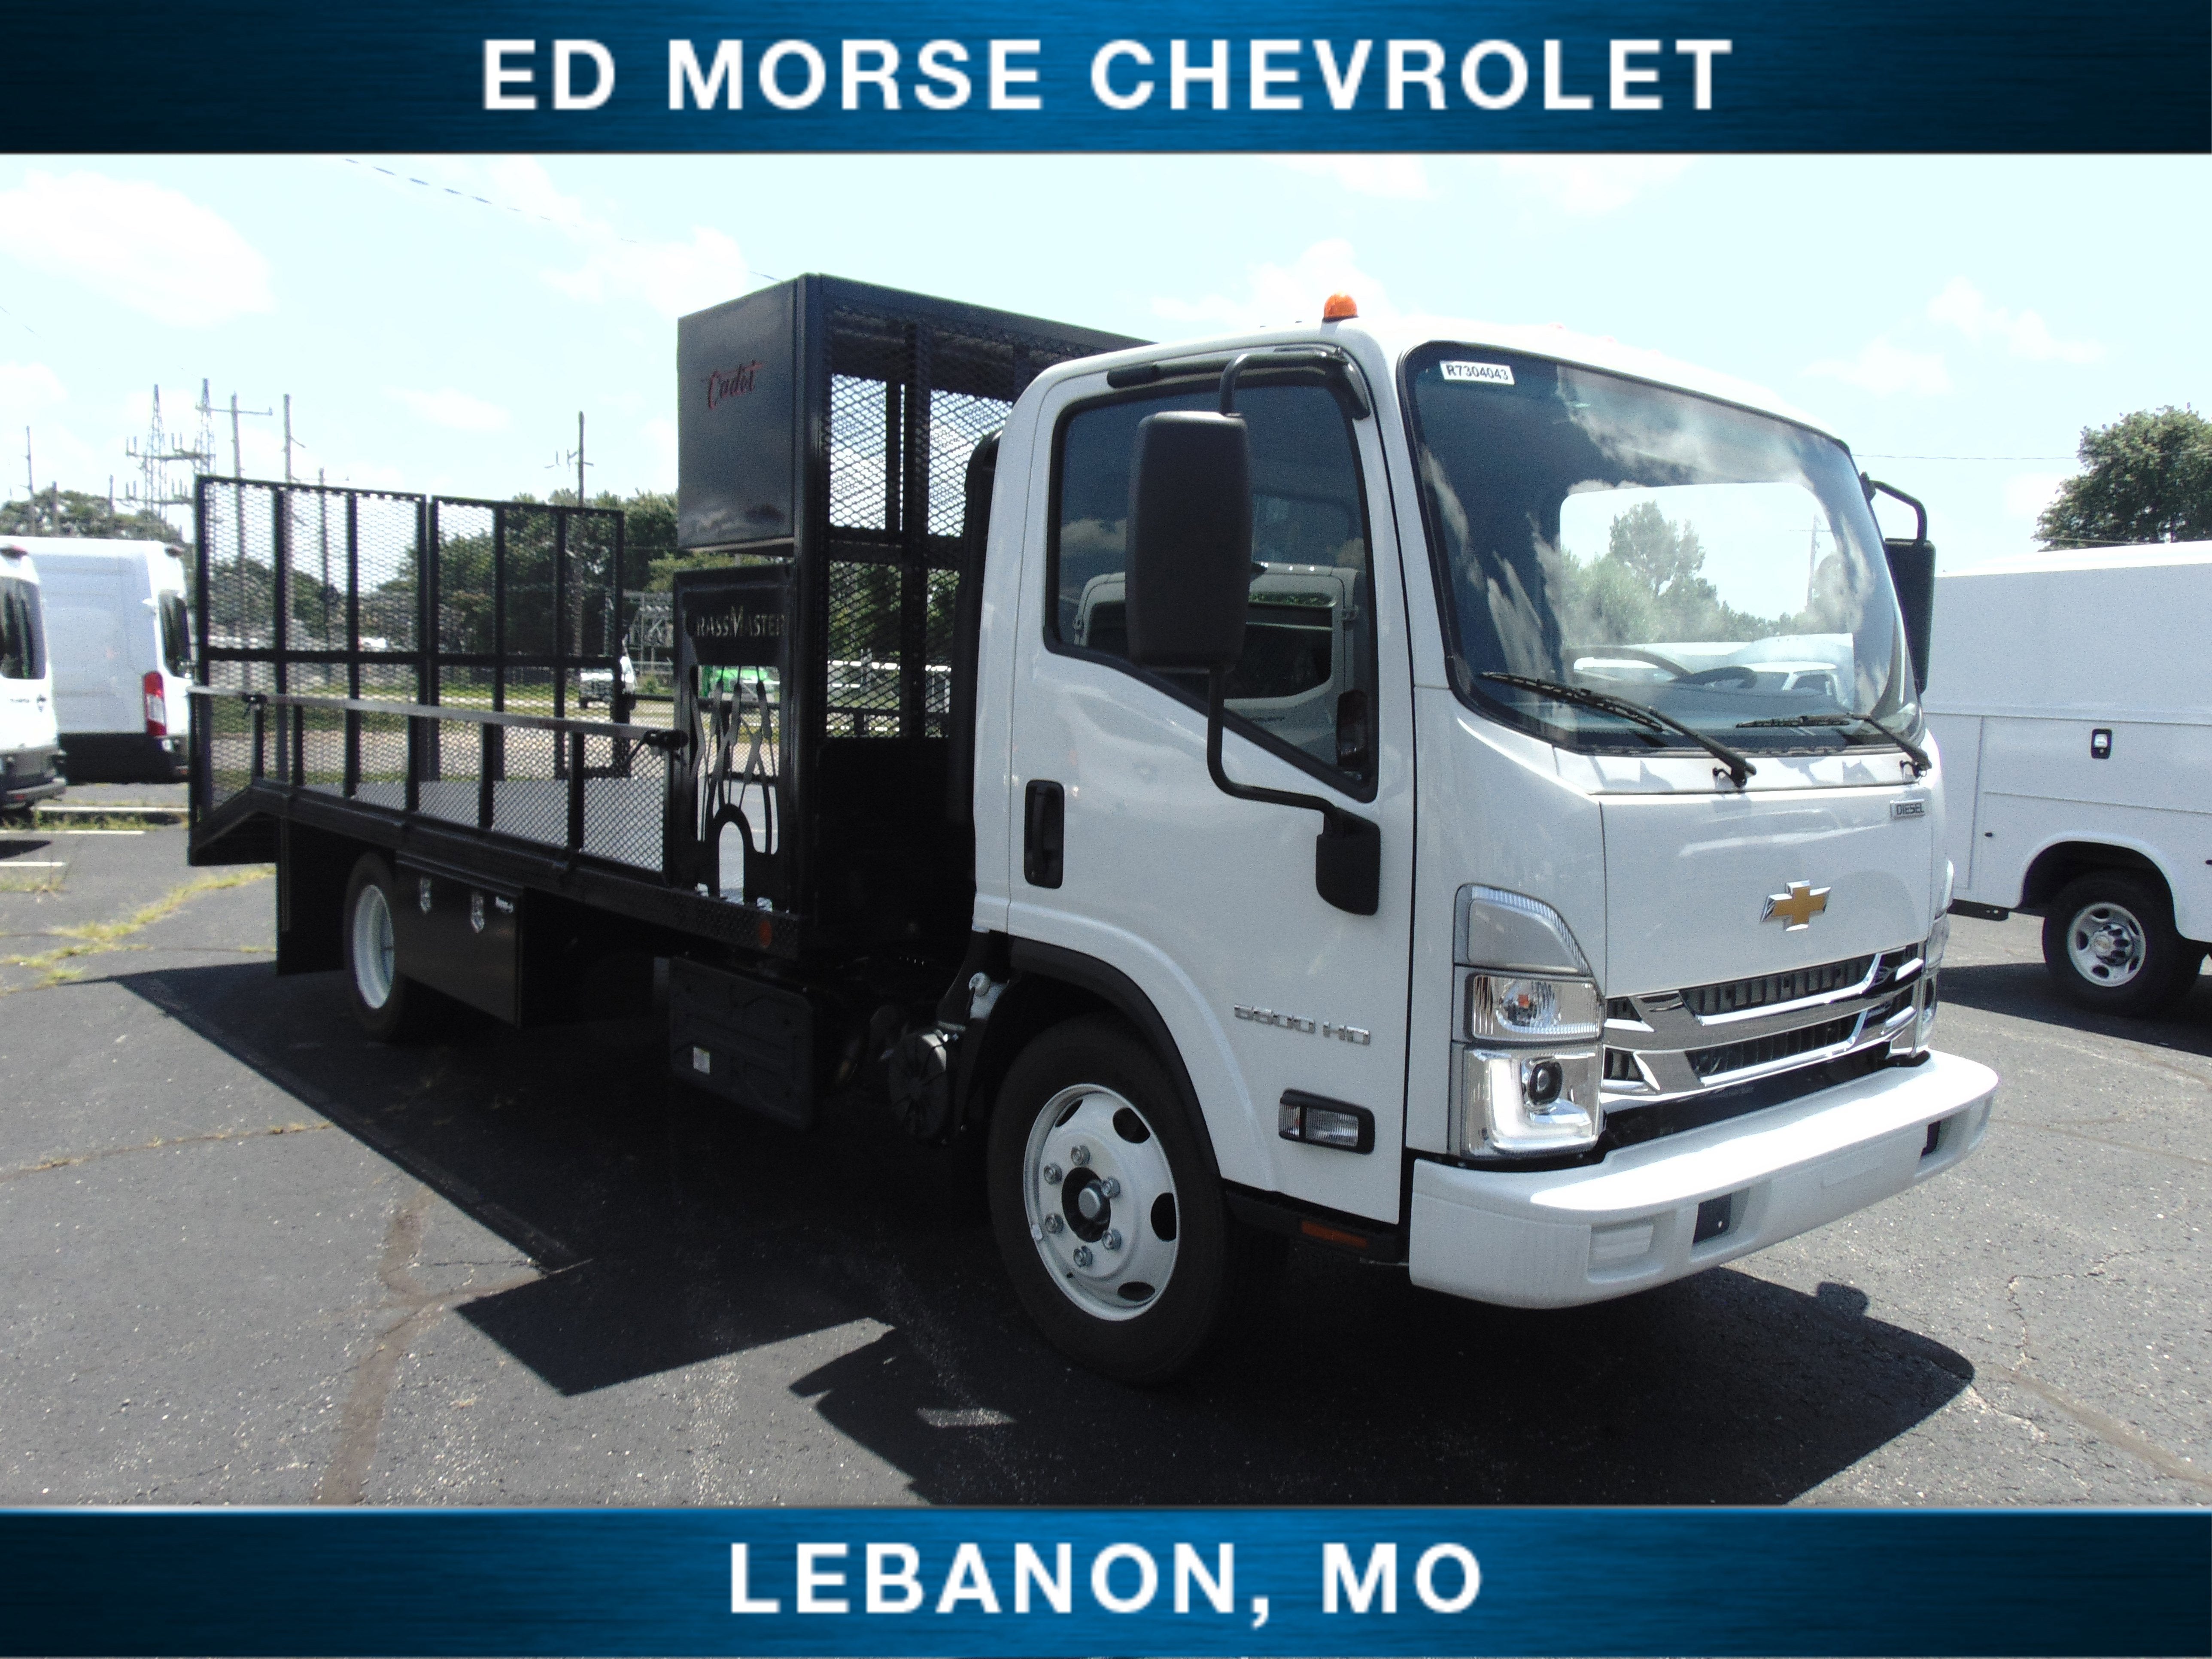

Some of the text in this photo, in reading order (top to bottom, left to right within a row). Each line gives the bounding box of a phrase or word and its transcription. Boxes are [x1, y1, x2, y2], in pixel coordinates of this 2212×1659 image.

[1446, 364, 1509, 380] R7304043
[1896, 803, 1924, 815] DIESEL
[1322, 1021, 1371, 1045] HD
